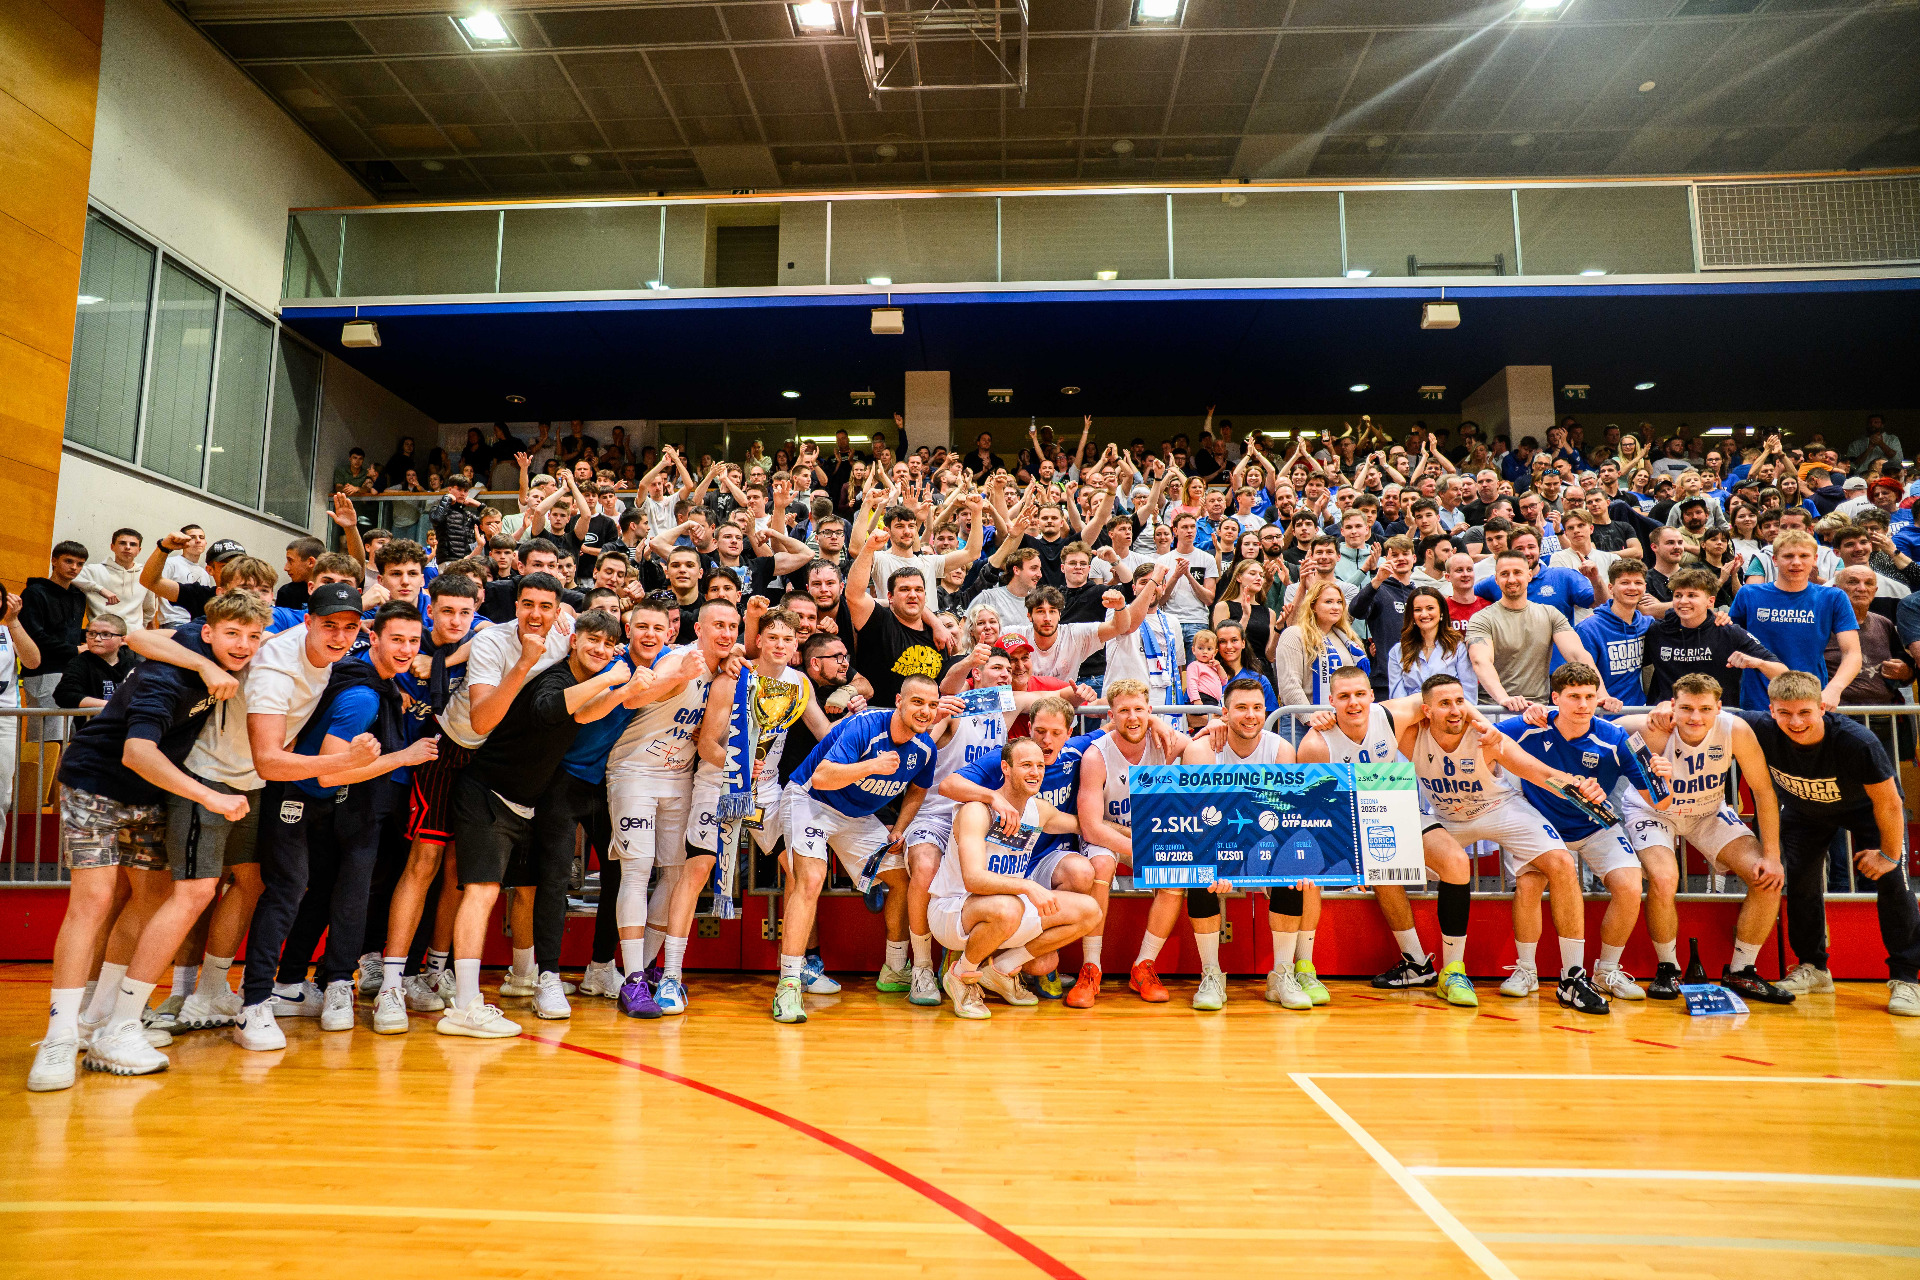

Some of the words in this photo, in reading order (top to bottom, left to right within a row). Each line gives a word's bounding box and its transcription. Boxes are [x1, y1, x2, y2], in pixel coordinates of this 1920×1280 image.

[1771, 608, 1815, 618] GORICA
[1673, 647, 1712, 657] GORICA
[983, 718, 995, 739] 11
[1443, 755, 1456, 776] 8
[1684, 752, 1706, 775] 14
[1155, 775, 1173, 784] KZS
[1179, 772, 1261, 787] BOARDING
[1263, 771, 1306, 785] PASS
[1770, 769, 1841, 795] GORICA
[1151, 816, 1204, 833] 2.SKL
[1281, 819, 1300, 828] OTP
[1300, 819, 1333, 828] BANKA
[1717, 810, 1744, 826] 14
[1543, 824, 1560, 840] 8
[1617, 836, 1634, 854] 5
[1155, 851, 1193, 861] 09/2026
[1217, 850, 1244, 861] KZS01
[1260, 850, 1272, 860] 26
[1296, 849, 1305, 860] 11
